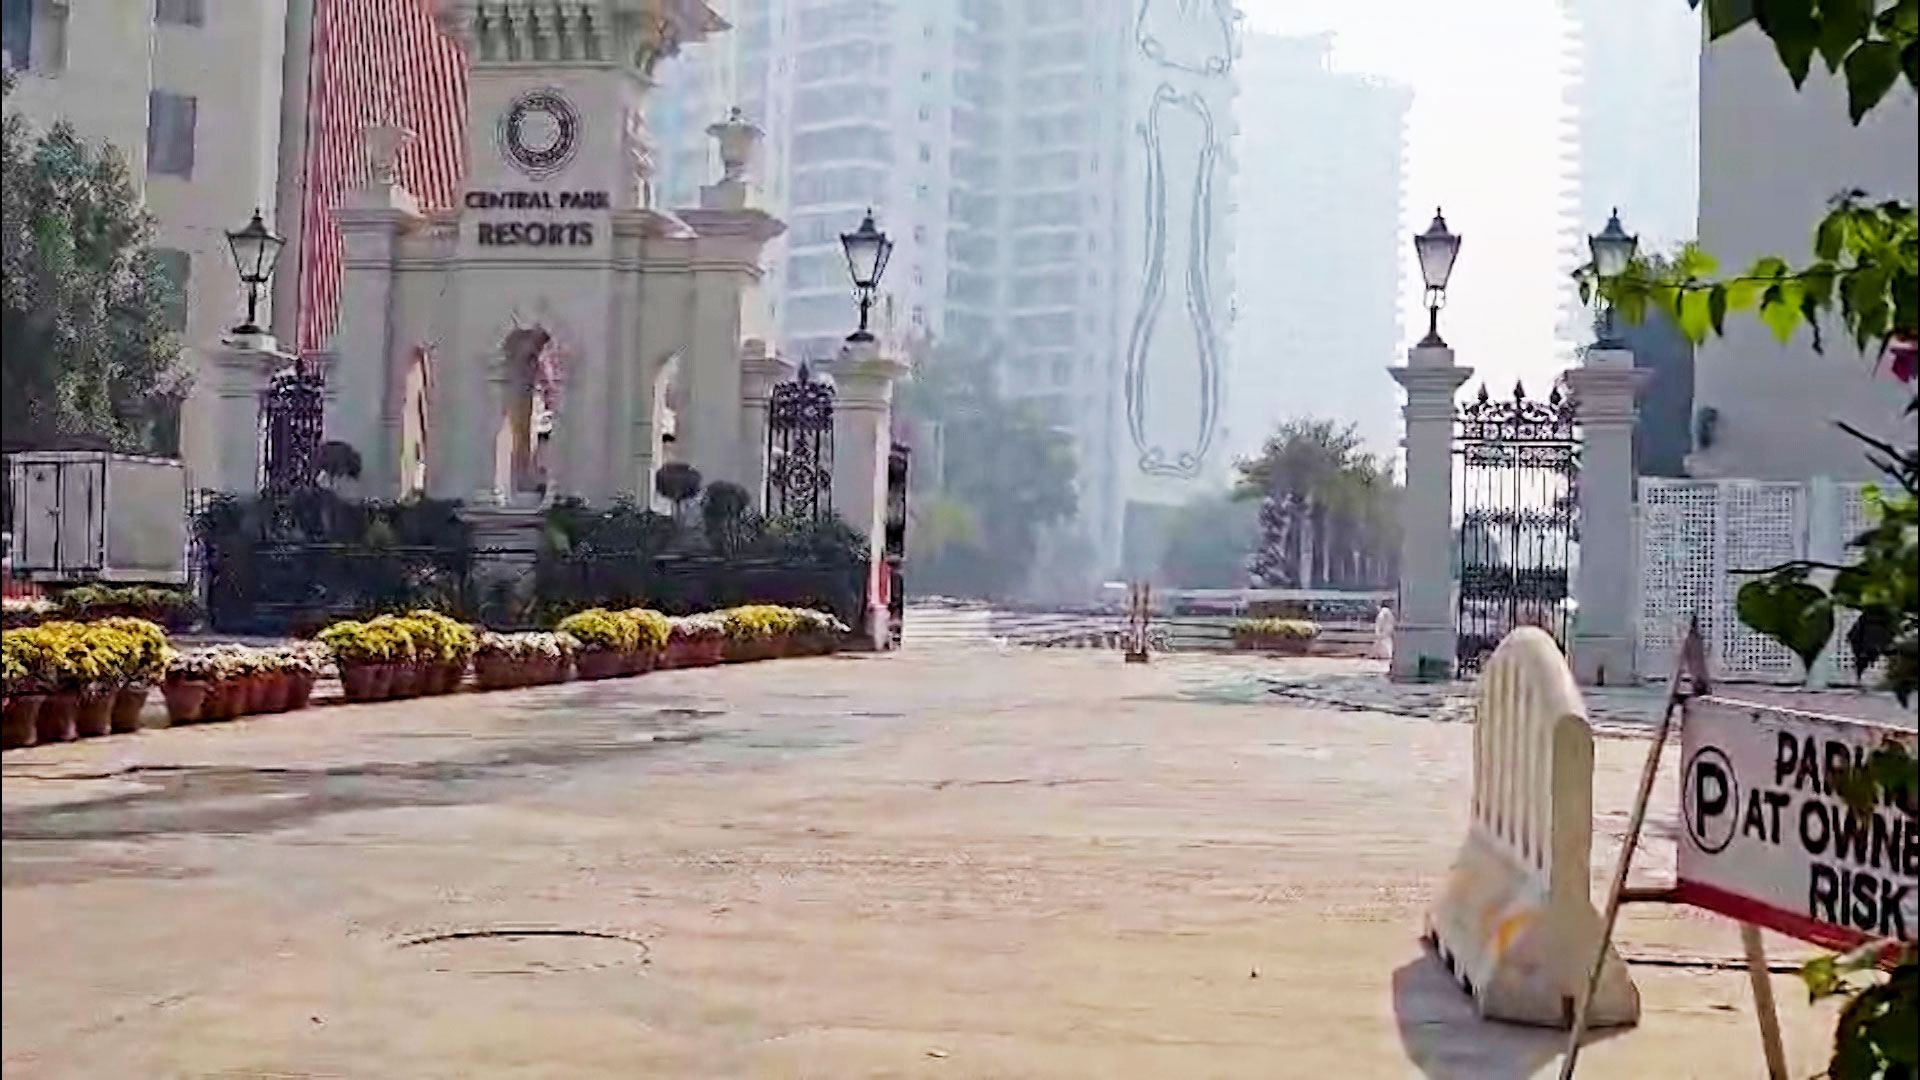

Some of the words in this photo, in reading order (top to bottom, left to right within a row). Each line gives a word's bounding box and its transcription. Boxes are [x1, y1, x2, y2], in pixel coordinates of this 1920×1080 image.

[465, 191, 554, 209] CENTRAL
[560, 191, 610, 210] PARK
[478, 222, 594, 246] RESORTS
[1697, 762, 1728, 837] P
[1743, 788, 1790, 844] AT
[1811, 861, 1908, 941] RISK
